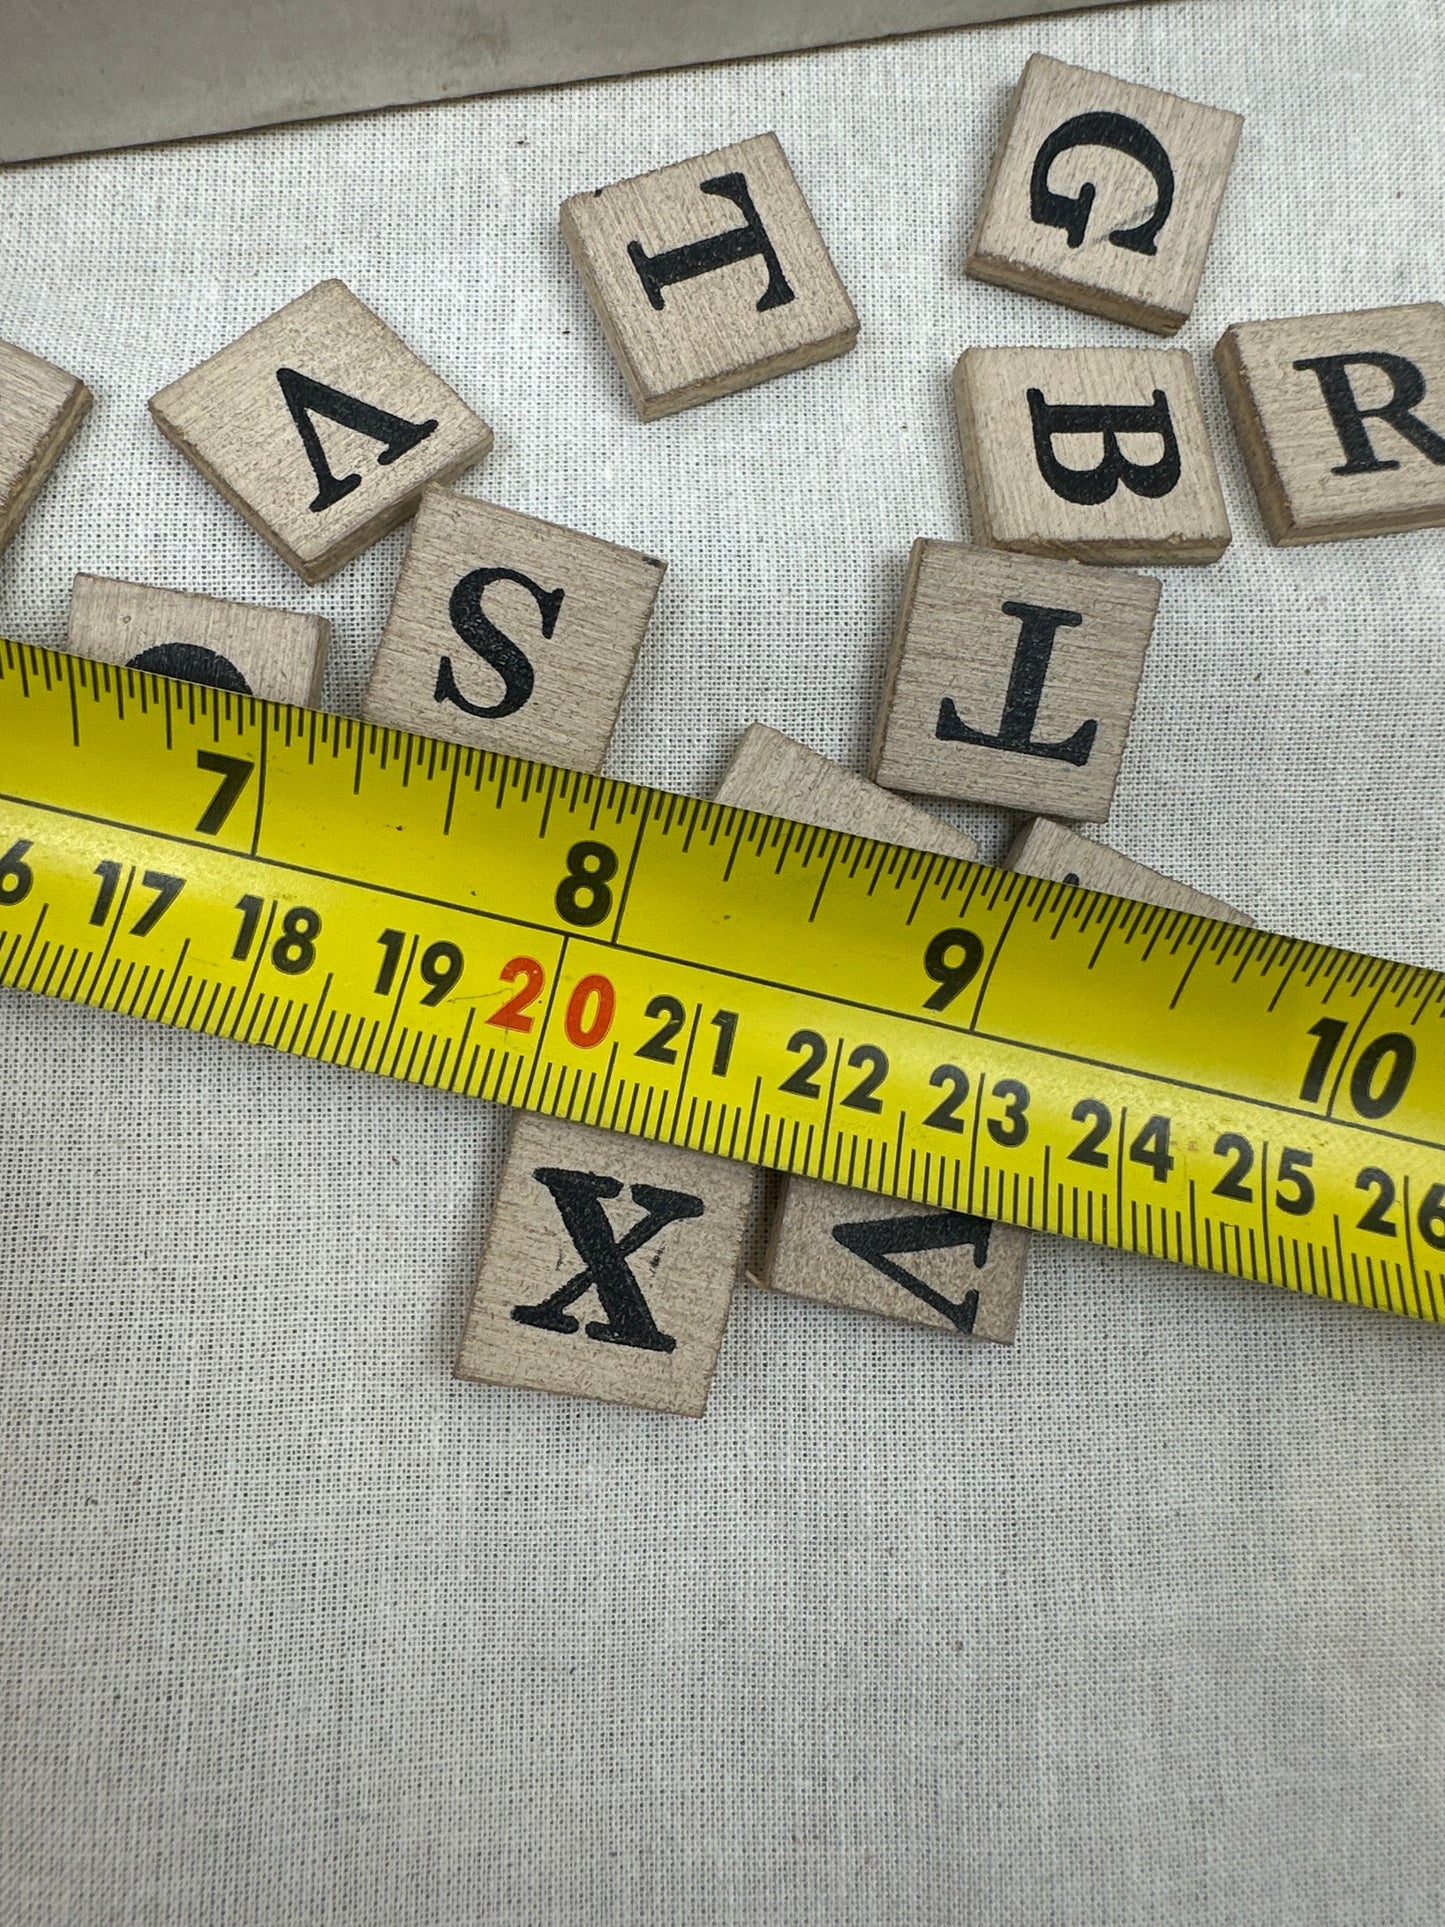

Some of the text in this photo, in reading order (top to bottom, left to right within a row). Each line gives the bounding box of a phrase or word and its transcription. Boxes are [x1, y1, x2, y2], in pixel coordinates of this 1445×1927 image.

[626, 171, 796, 312] T
[1029, 111, 1175, 256] G
[1026, 387, 1182, 506] B
[1292, 351, 1445, 477] R
[432, 566, 566, 719] S
[934, 600, 1099, 768] T
[195, 749, 1417, 1121] 7 8 9 10
[89, 862, 185, 937] 17
[231, 894, 321, 975] 18
[374, 928, 465, 1008] 19
[486, 956, 616, 1049] 20
[635, 995, 739, 1078] 21
[778, 1029, 888, 1114] 22
[923, 1064, 1030, 1148] 23
[1066, 1099, 1175, 1183] 24
[1211, 1133, 1316, 1217] 25
[1355, 1166, 1445, 1252] 26
[510, 1166, 706, 1355] X
